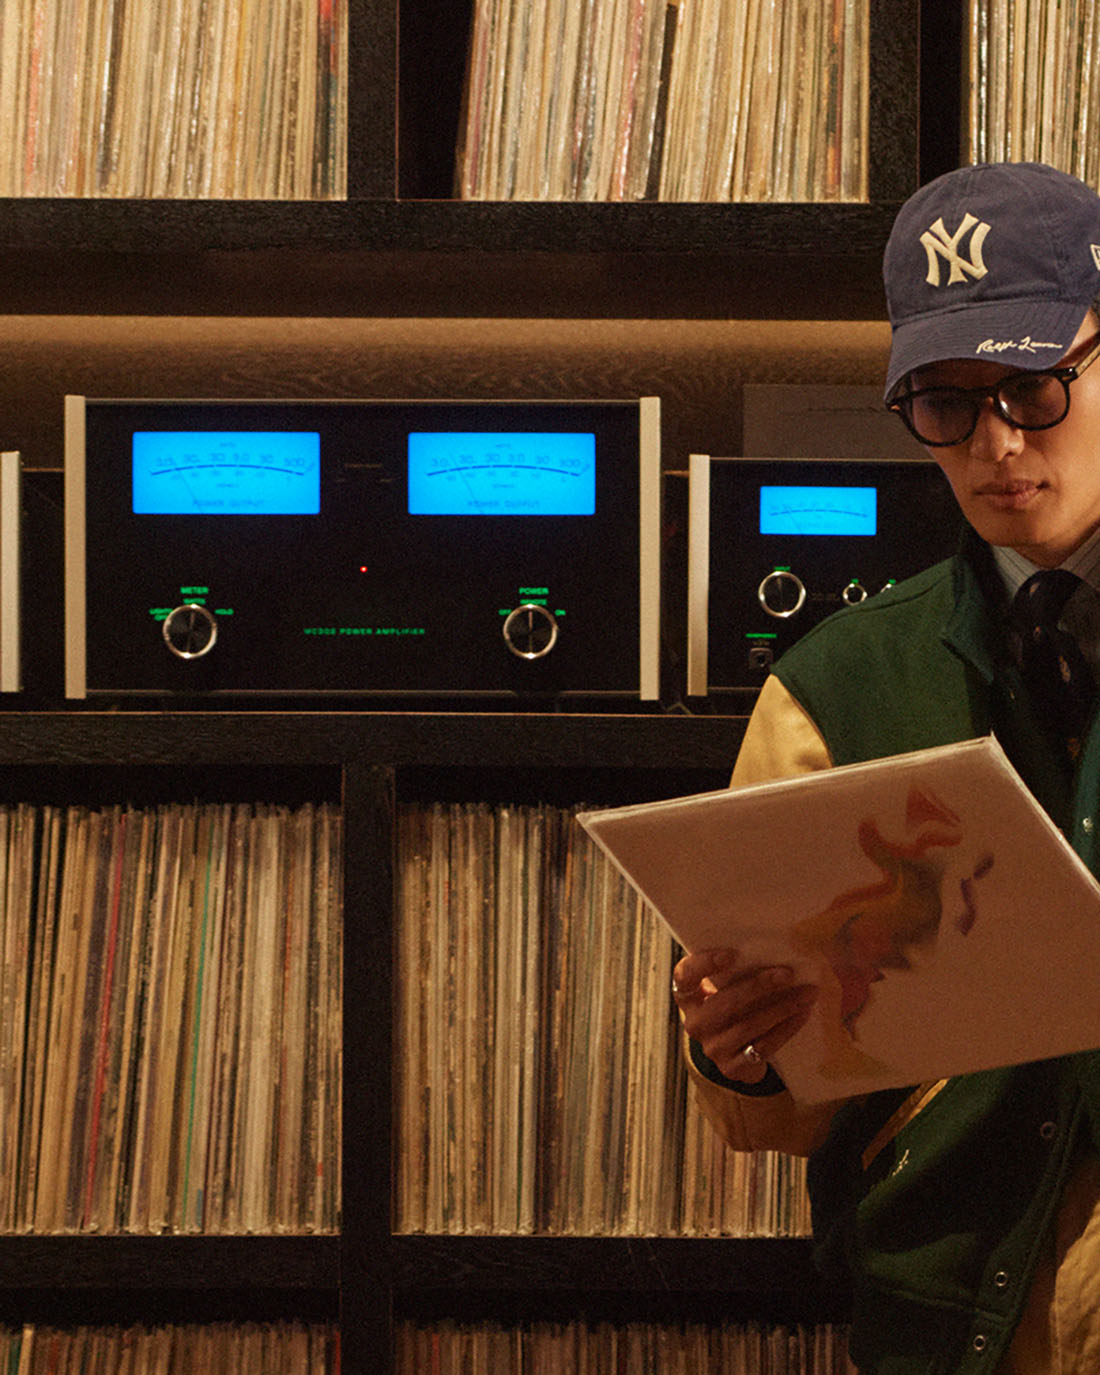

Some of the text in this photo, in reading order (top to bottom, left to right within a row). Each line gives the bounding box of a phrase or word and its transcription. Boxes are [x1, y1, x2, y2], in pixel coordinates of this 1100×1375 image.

[920, 212, 992, 288] NY
[976, 338, 1017, 354] Ralph
[180, 586, 209, 595] METER
[518, 587, 550, 596] POWER
[339, 627, 373, 636] POWER
[375, 627, 425, 637] AMPLIFIER
